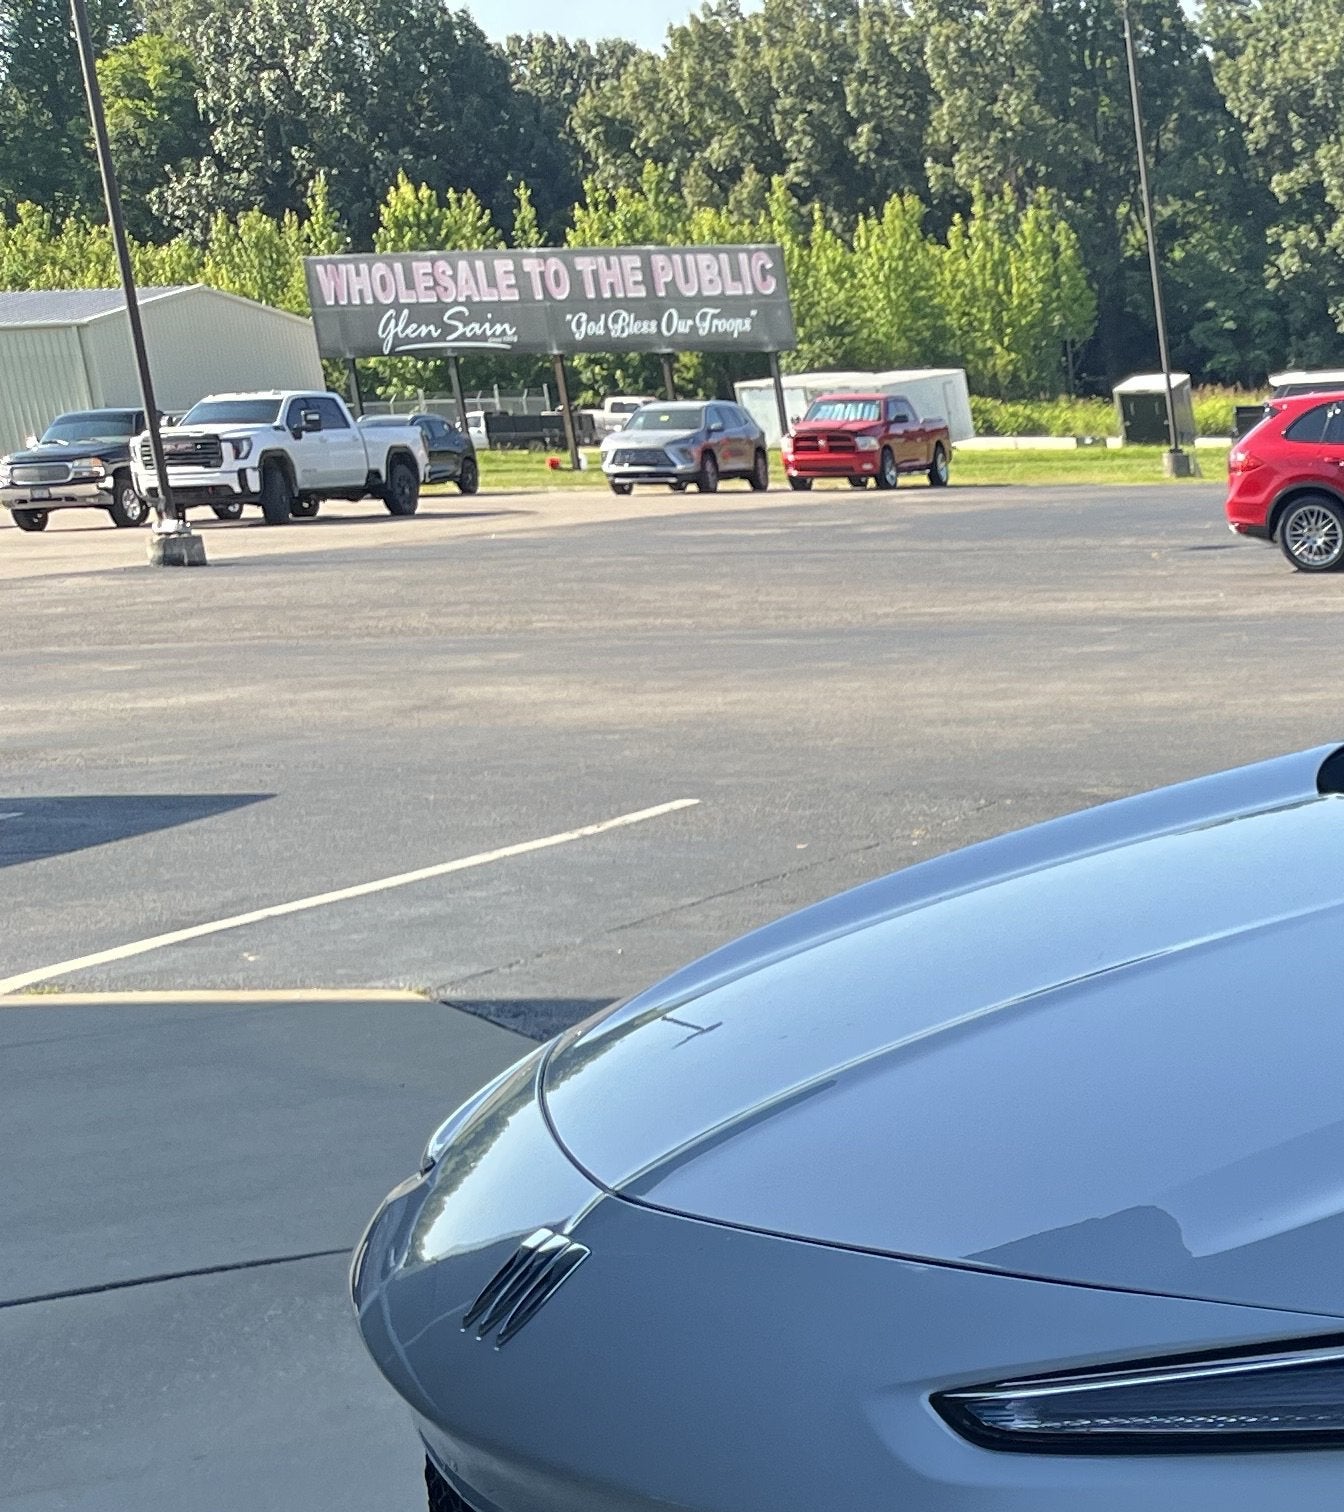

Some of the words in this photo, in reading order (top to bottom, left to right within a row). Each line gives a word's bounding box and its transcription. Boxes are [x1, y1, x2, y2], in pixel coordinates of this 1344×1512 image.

[315, 258, 520, 306] WHOLESALE
[522, 256, 571, 301] TO
[574, 254, 647, 299] THE
[650, 250, 777, 297] PUBLIC
[377, 308, 441, 355] Glen
[442, 306, 517, 341] Sain
[607, 309, 658, 339] Bless
[660, 308, 694, 337] Our
